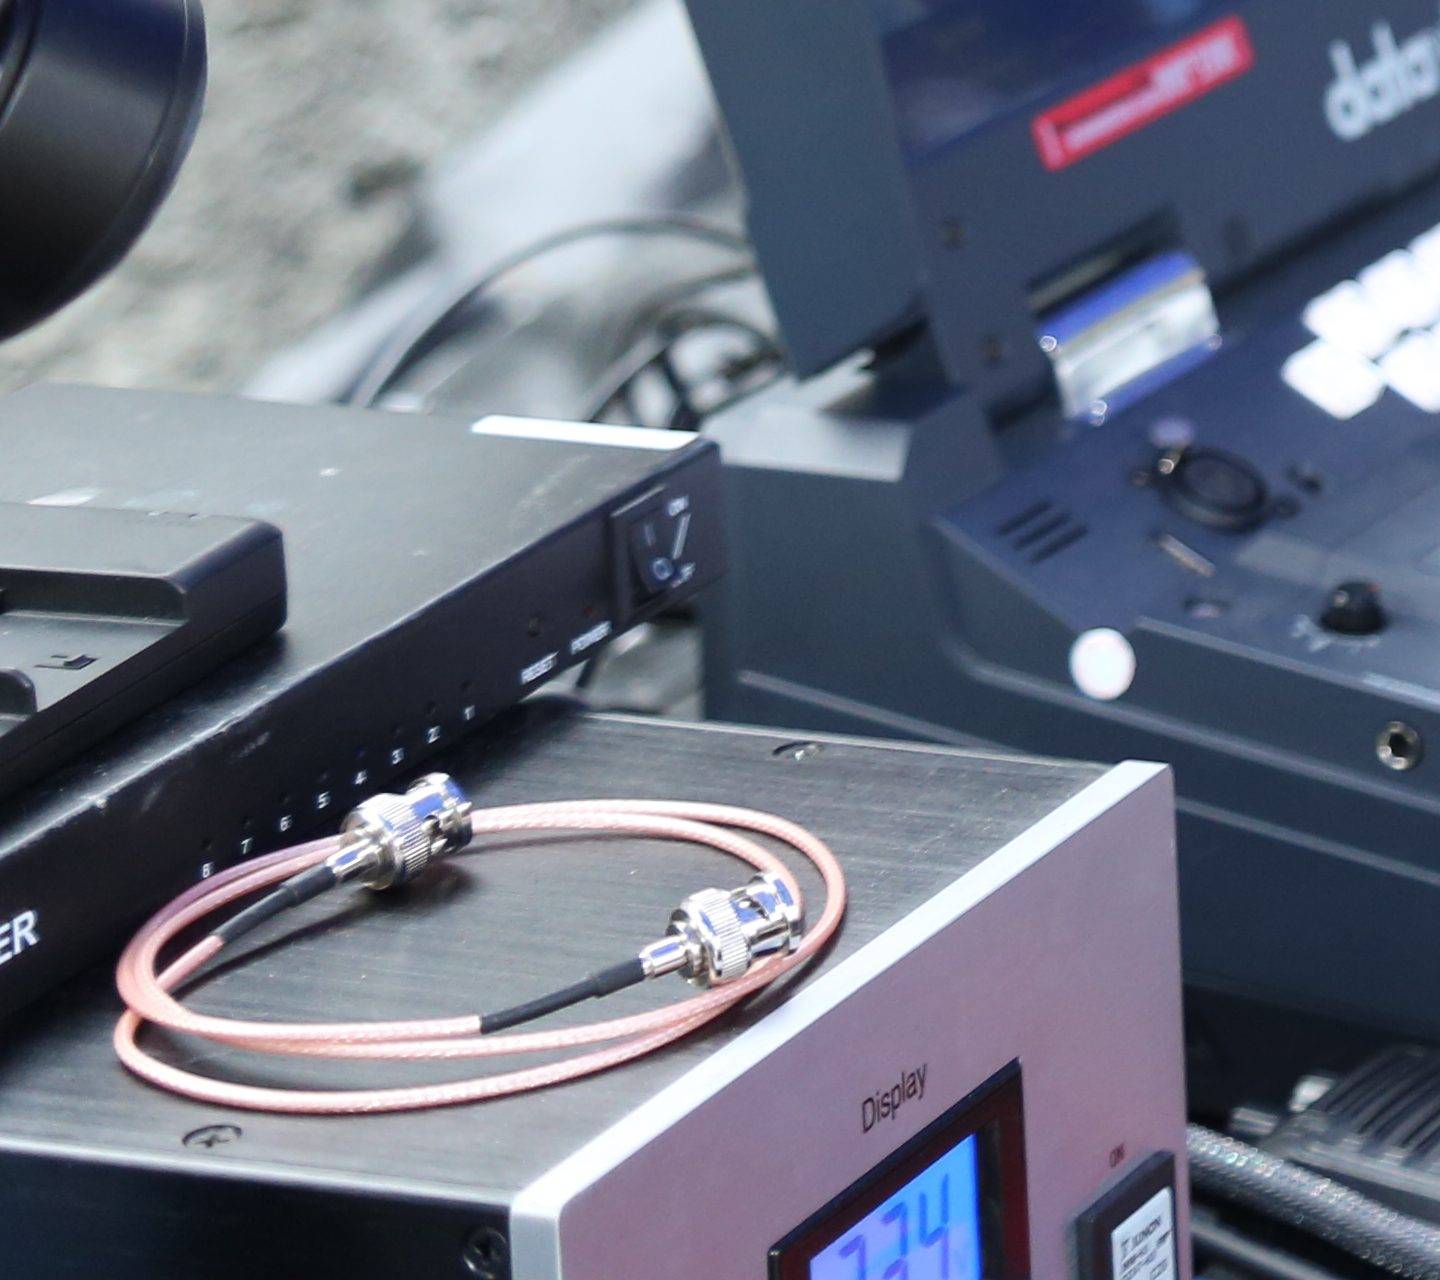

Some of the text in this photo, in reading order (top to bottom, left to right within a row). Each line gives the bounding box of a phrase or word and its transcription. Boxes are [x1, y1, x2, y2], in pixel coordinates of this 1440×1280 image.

[241, 837, 253, 854] 7
[280, 815, 292, 832] 6
[316, 792, 331, 809] 5
[354, 770, 368, 785] 4
[391, 748, 404, 764] 3
[426, 726, 441, 743] 2
[463, 704, 476, 721] 1
[862, 1063, 928, 1134] Display
